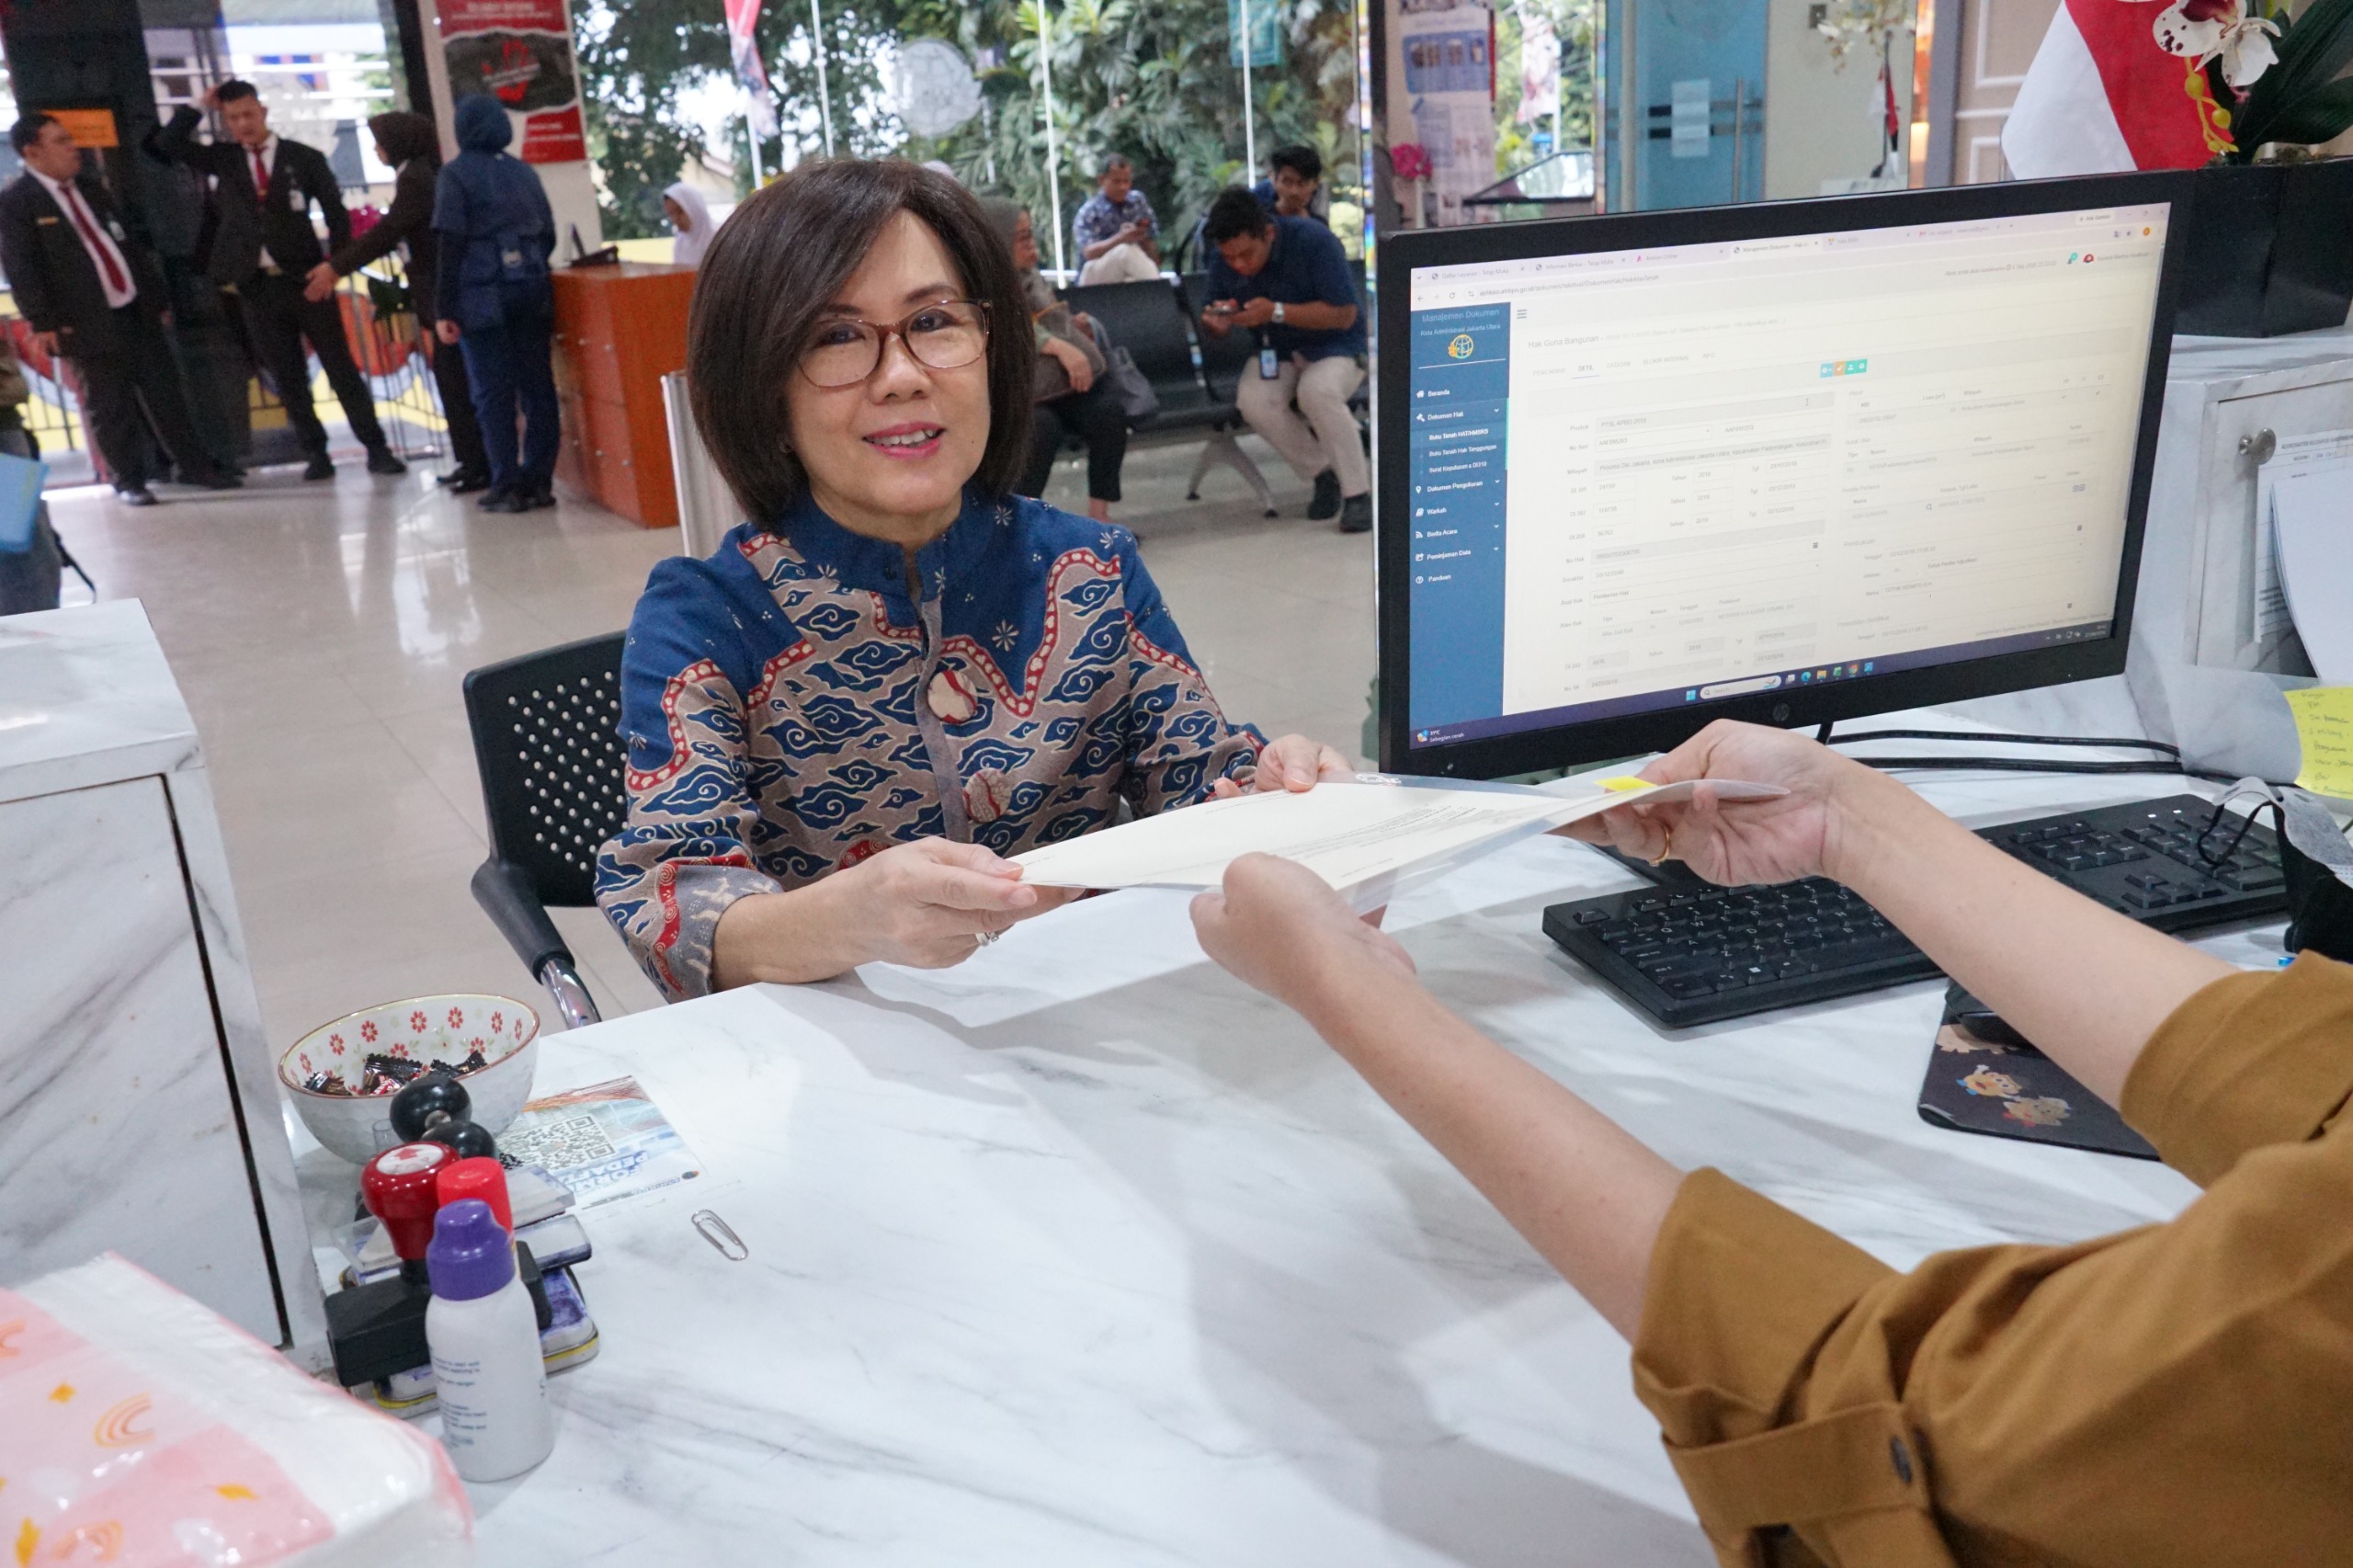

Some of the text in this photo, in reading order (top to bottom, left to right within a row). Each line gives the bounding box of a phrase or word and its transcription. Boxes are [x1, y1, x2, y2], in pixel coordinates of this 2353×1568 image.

[1423, 309, 1500, 323] Manajemen Dokumen
[1528, 340, 1542, 348] Hak
[1564, 335, 1599, 346] Bangunan
[1427, 389, 1450, 397] Beranda
[1427, 413, 1452, 421] Dokumen
[1452, 481, 1483, 490] Pengukuran
[1427, 506, 1447, 515] Warkah
